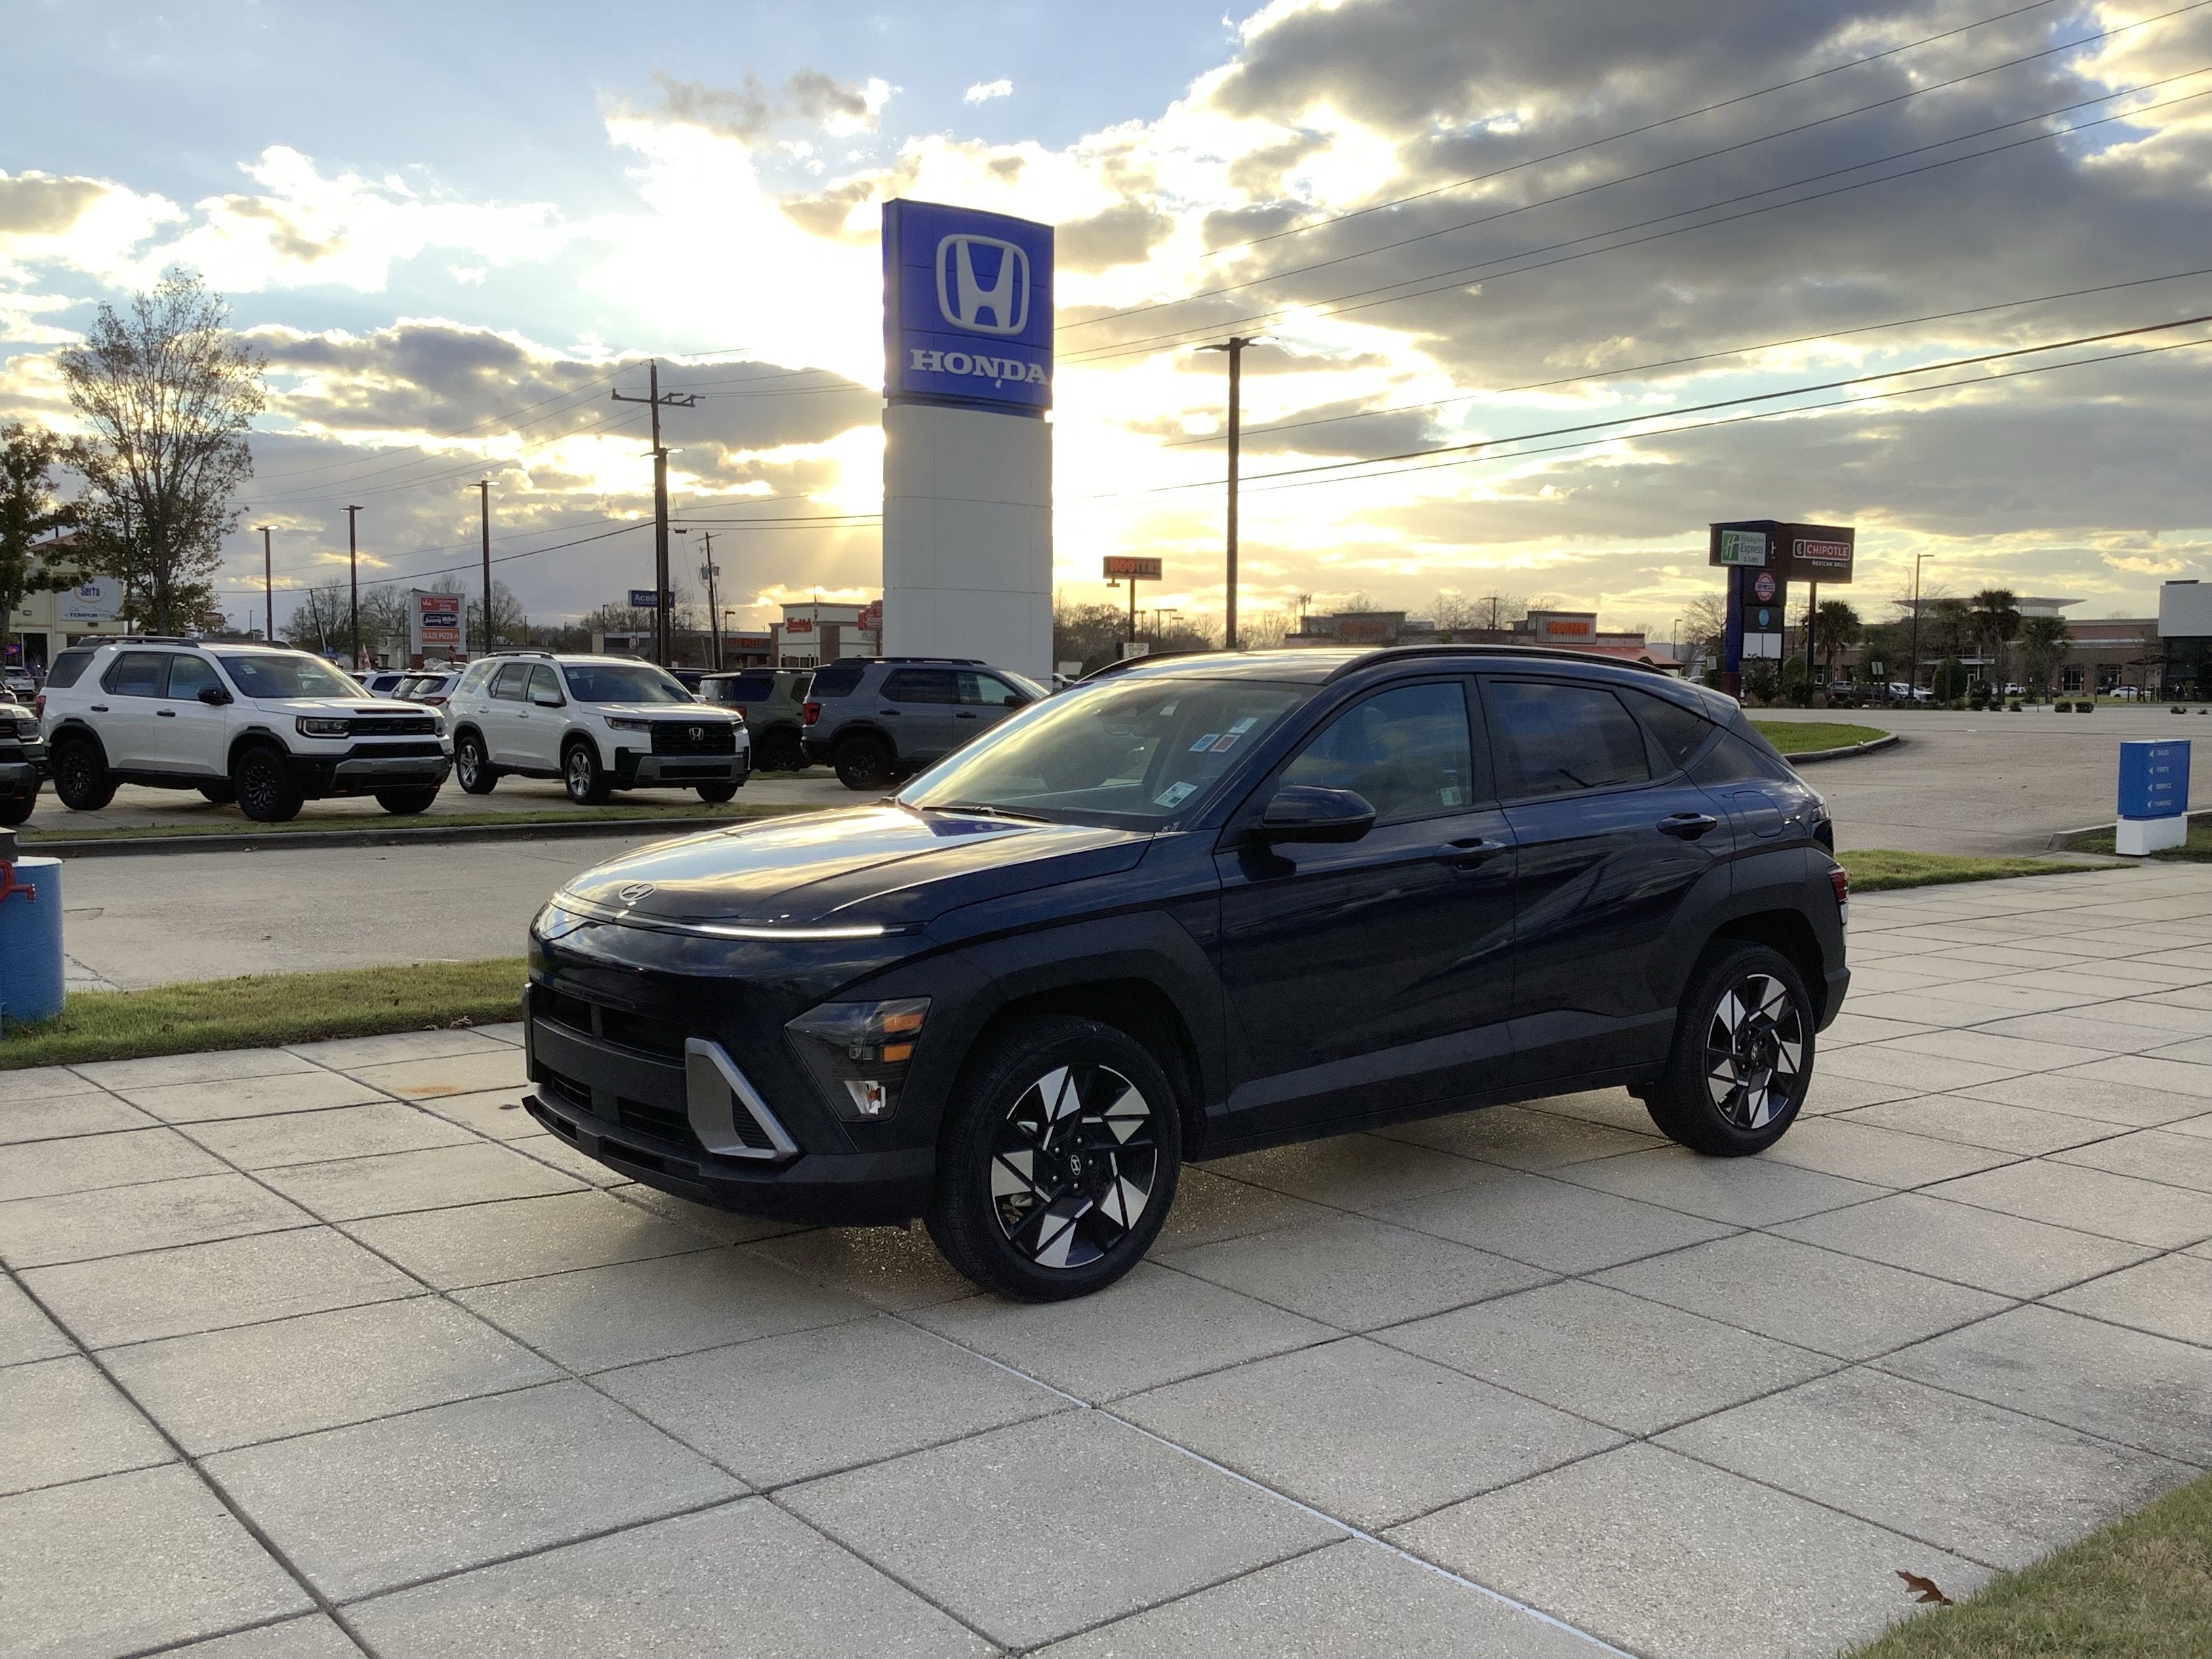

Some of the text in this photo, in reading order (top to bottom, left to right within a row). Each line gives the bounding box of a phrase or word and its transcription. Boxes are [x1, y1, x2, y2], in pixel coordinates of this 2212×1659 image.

[910, 349, 1049, 384] HONDA
[1740, 543, 1764, 554] Express
[1807, 545, 1848, 556] CHIPOTLE
[1109, 558, 1160, 573] HOOTERS
[81, 586, 100, 596] Serta
